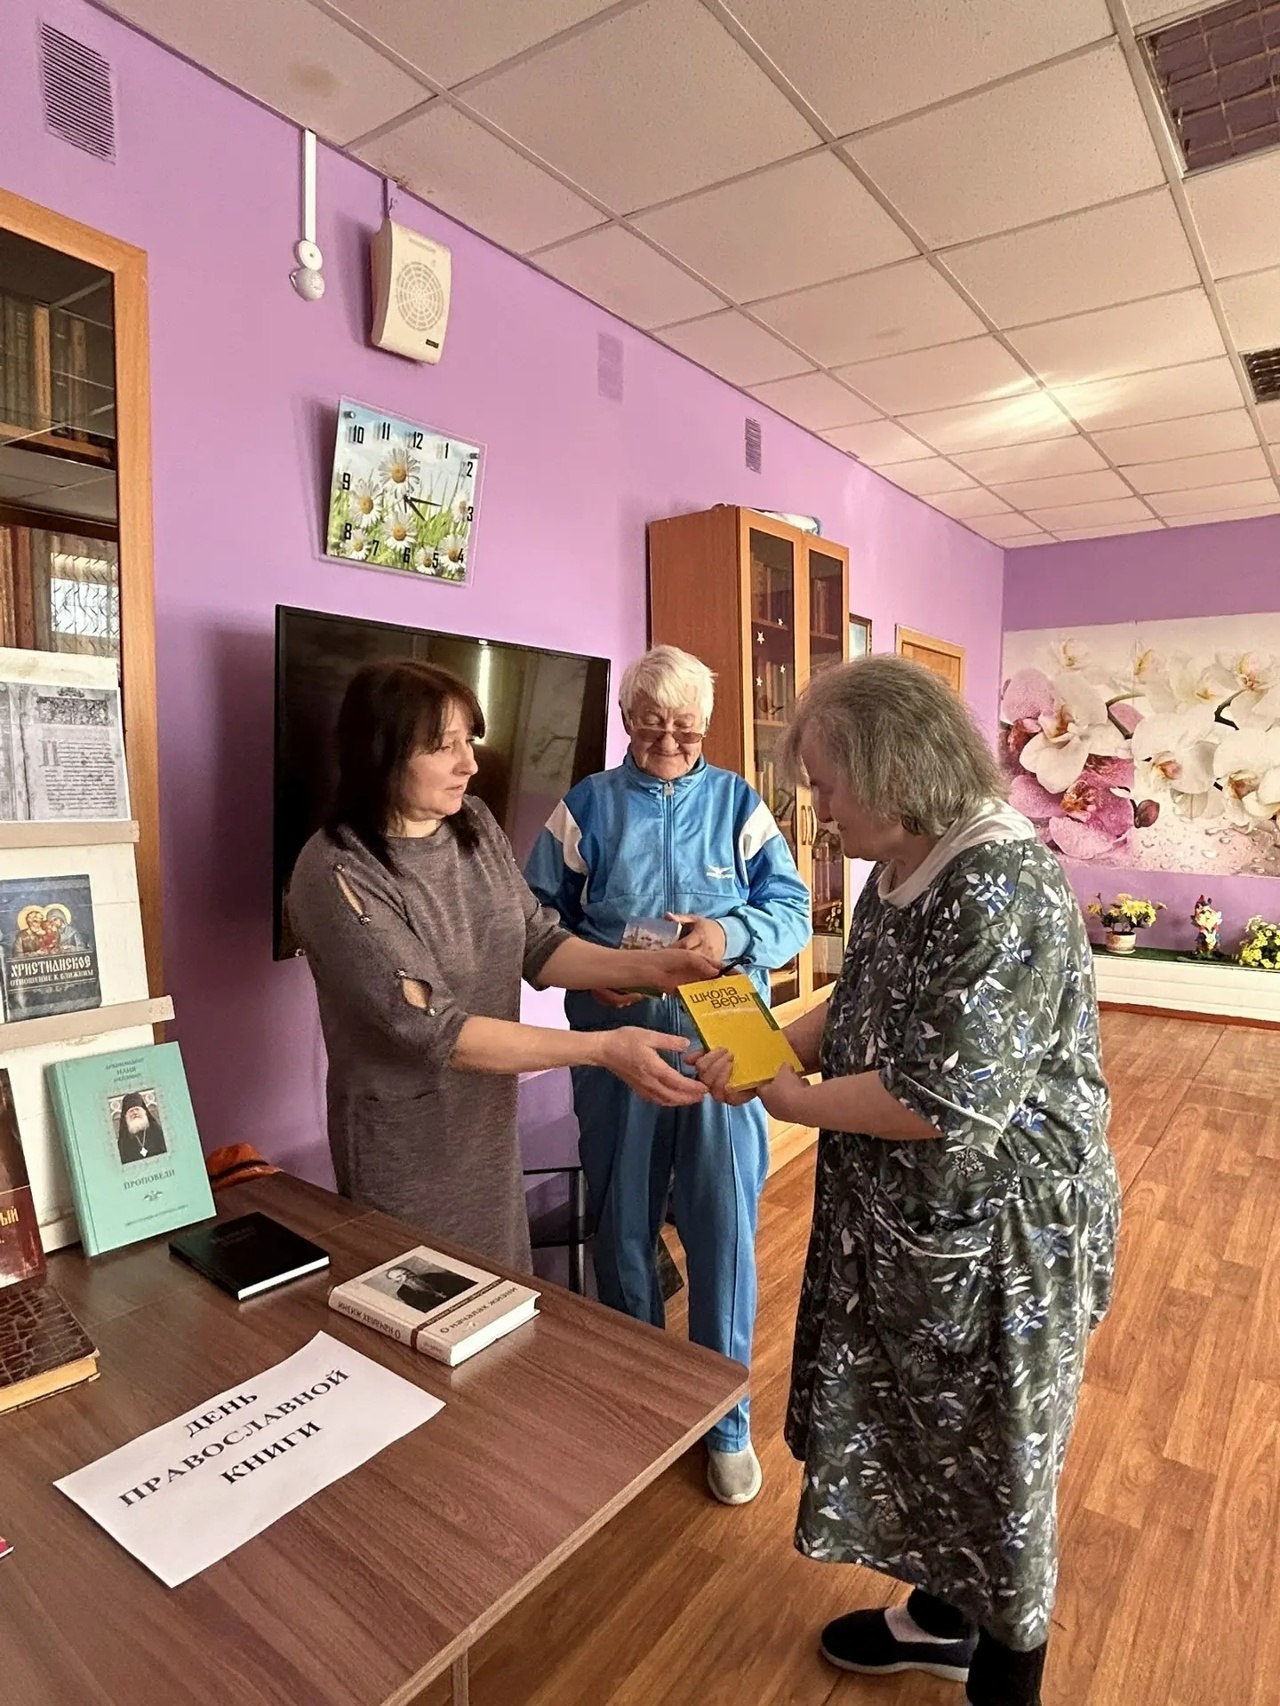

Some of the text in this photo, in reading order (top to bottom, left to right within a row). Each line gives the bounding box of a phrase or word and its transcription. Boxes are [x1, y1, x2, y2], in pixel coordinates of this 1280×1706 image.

[353, 425, 364, 444] 10
[382, 422, 391, 440] 11
[413, 431, 424, 450] 12
[466, 461, 473, 477] 2
[342, 473, 350, 490] 9
[467, 507, 474, 521] 3
[344, 523, 352, 540] 8
[372, 539, 380, 556] 7
[403, 547, 411, 563] 6
[457, 548, 464, 563] 4
[432, 553, 439, 569] 5
[10, 955, 91, 978] ХРИСТИАНСКОЕ
[689, 986, 738, 1004] школа
[711, 994, 751, 1009] веры
[123, 1169, 175, 1190] ПРОПОВЕДИ
[0, 1206, 19, 1226] ЫЙ
[439, 1325, 450, 1334] О
[183, 1392, 259, 1438] ДЕНЬ
[118, 1368, 351, 1508] ПРАВОСЛАВНОЙ
[218, 1420, 324, 1485] КНИГИ
